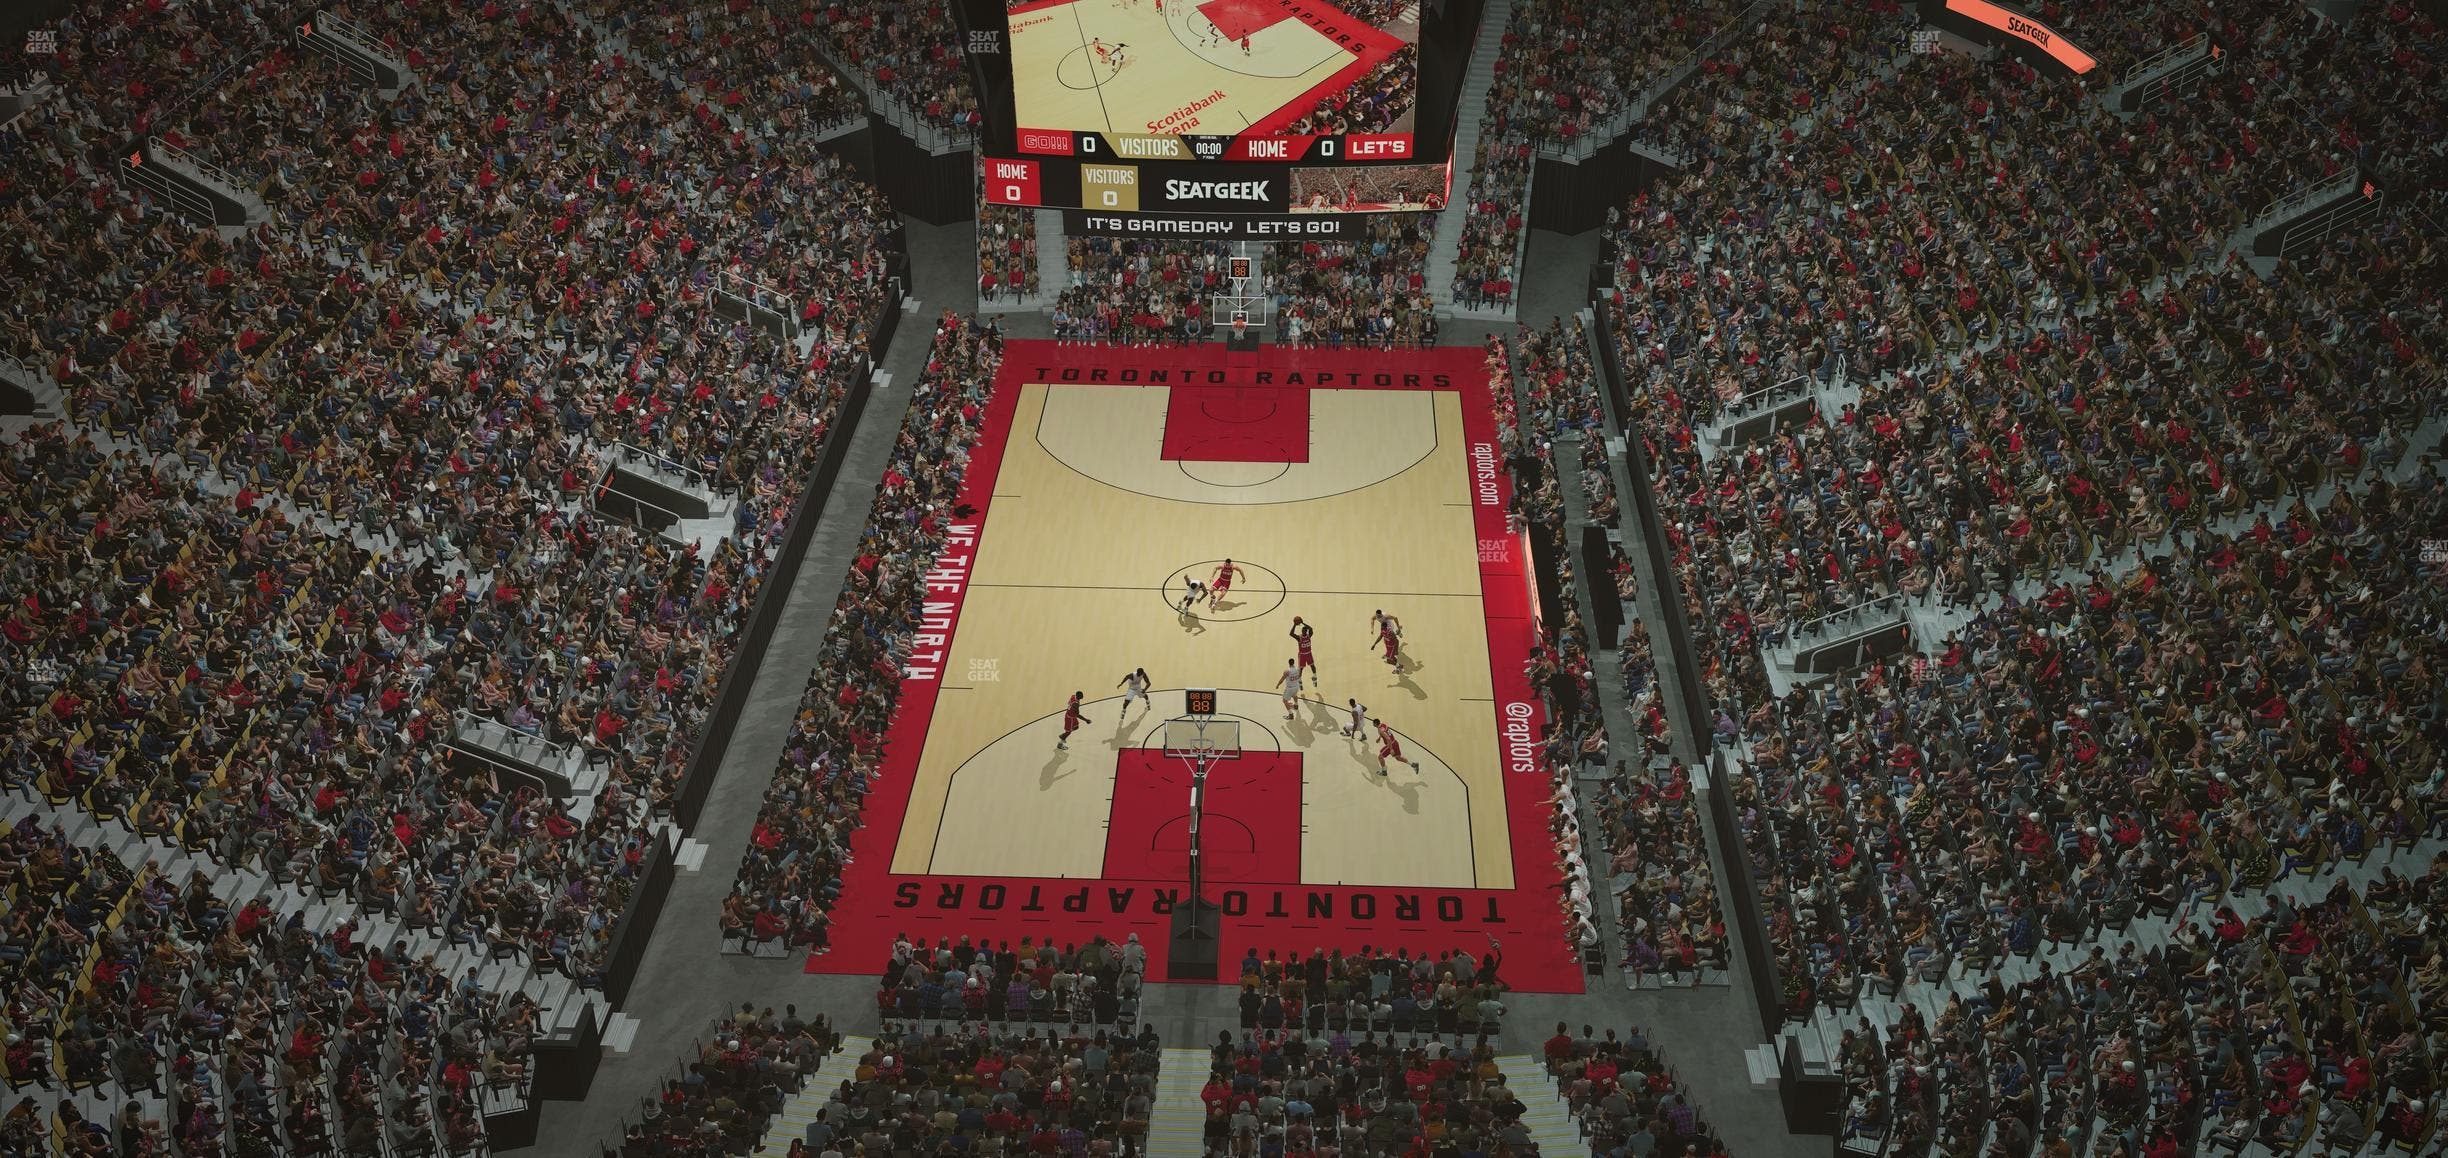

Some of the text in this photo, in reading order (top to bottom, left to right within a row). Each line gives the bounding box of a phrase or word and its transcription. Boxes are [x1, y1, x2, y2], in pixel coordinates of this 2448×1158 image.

[1280, 0, 1366, 52] RAPTORS
[2007, 17, 2051, 48] SEATGEEK
[1147, 90, 1226, 134] Scotiabank
[1024, 135, 1068, 150] GO!!!
[1082, 136, 1096, 153] 0
[1120, 137, 1179, 156] VISITORS
[1196, 142, 1222, 155] 00:00
[1248, 140, 1288, 158] HOME
[1321, 140, 1334, 157] 0
[1352, 140, 1405, 154] LET'S
[997, 163, 1028, 180] HOME
[1085, 168, 1134, 185] VISITORS
[1006, 185, 1021, 201] 0
[1103, 190, 1118, 206] 0
[1165, 179, 1270, 202] SEATGEEK
[1087, 217, 1340, 234] IT'S GAMEDAY LET'S GO!
[1035, 368, 1451, 388] TORONTO RAPTORS
[1470, 442, 1500, 505] raptors.com
[925, 555, 968, 594] THE
[902, 602, 955, 680] NORTH
[1503, 702, 1536, 773] @raptors
[893, 882, 1506, 923] TORONTO RAPTORS
